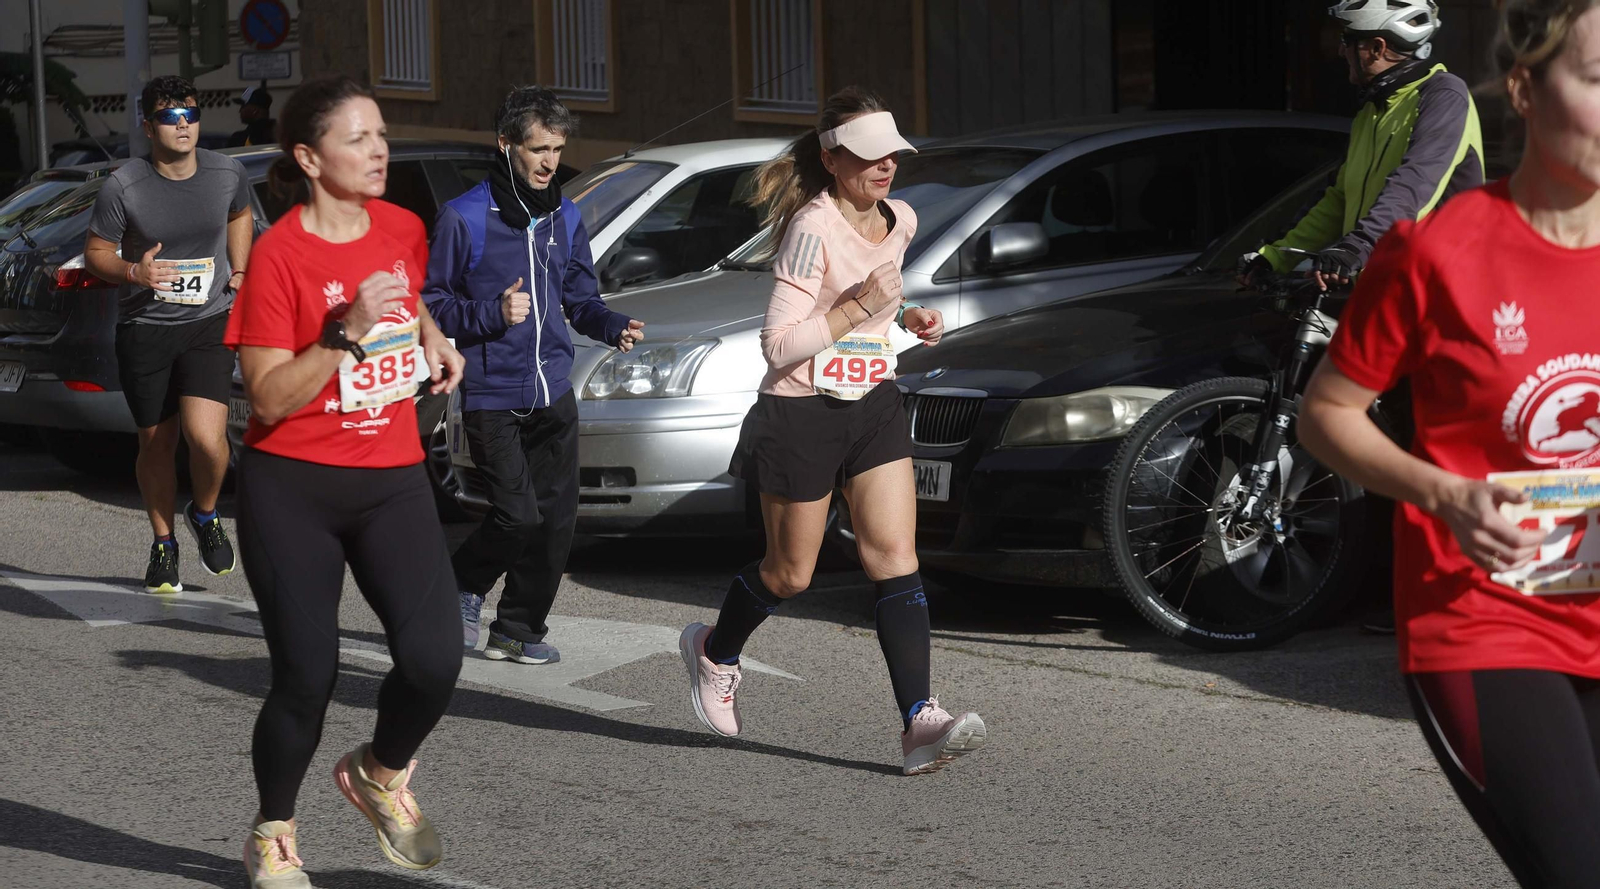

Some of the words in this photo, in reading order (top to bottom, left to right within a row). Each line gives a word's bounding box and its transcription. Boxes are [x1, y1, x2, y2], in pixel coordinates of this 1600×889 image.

[352, 348, 415, 390] 385
[822, 357, 887, 383] 492
[1275, 414, 1291, 428] 32
[913, 464, 941, 496] MN
